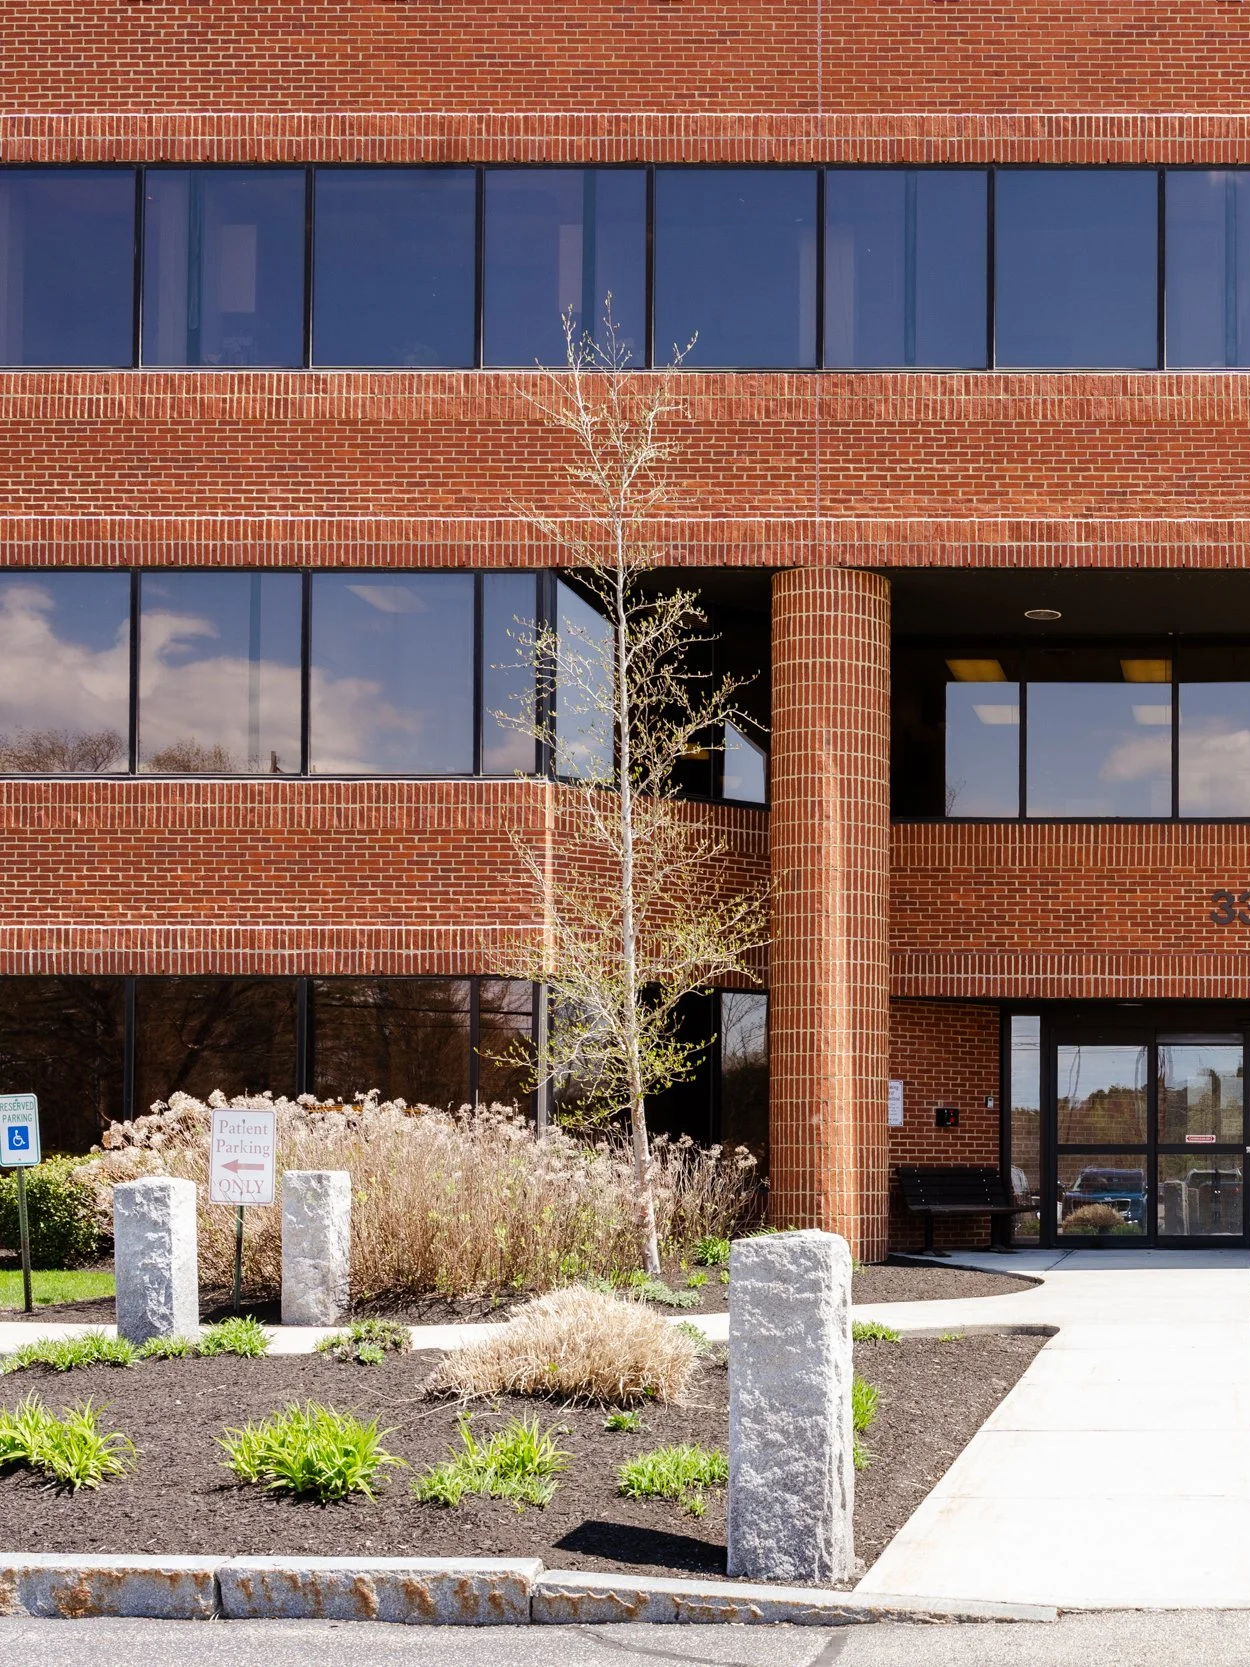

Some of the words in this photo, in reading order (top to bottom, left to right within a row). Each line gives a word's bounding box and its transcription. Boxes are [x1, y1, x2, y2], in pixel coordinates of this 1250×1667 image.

[0, 1101, 34, 1112] RESERVED
[2, 1113, 33, 1123] PARKING
[219, 1119, 268, 1135] Patient
[216, 1138, 271, 1158] Parking
[218, 1178, 264, 1194] ONLY
